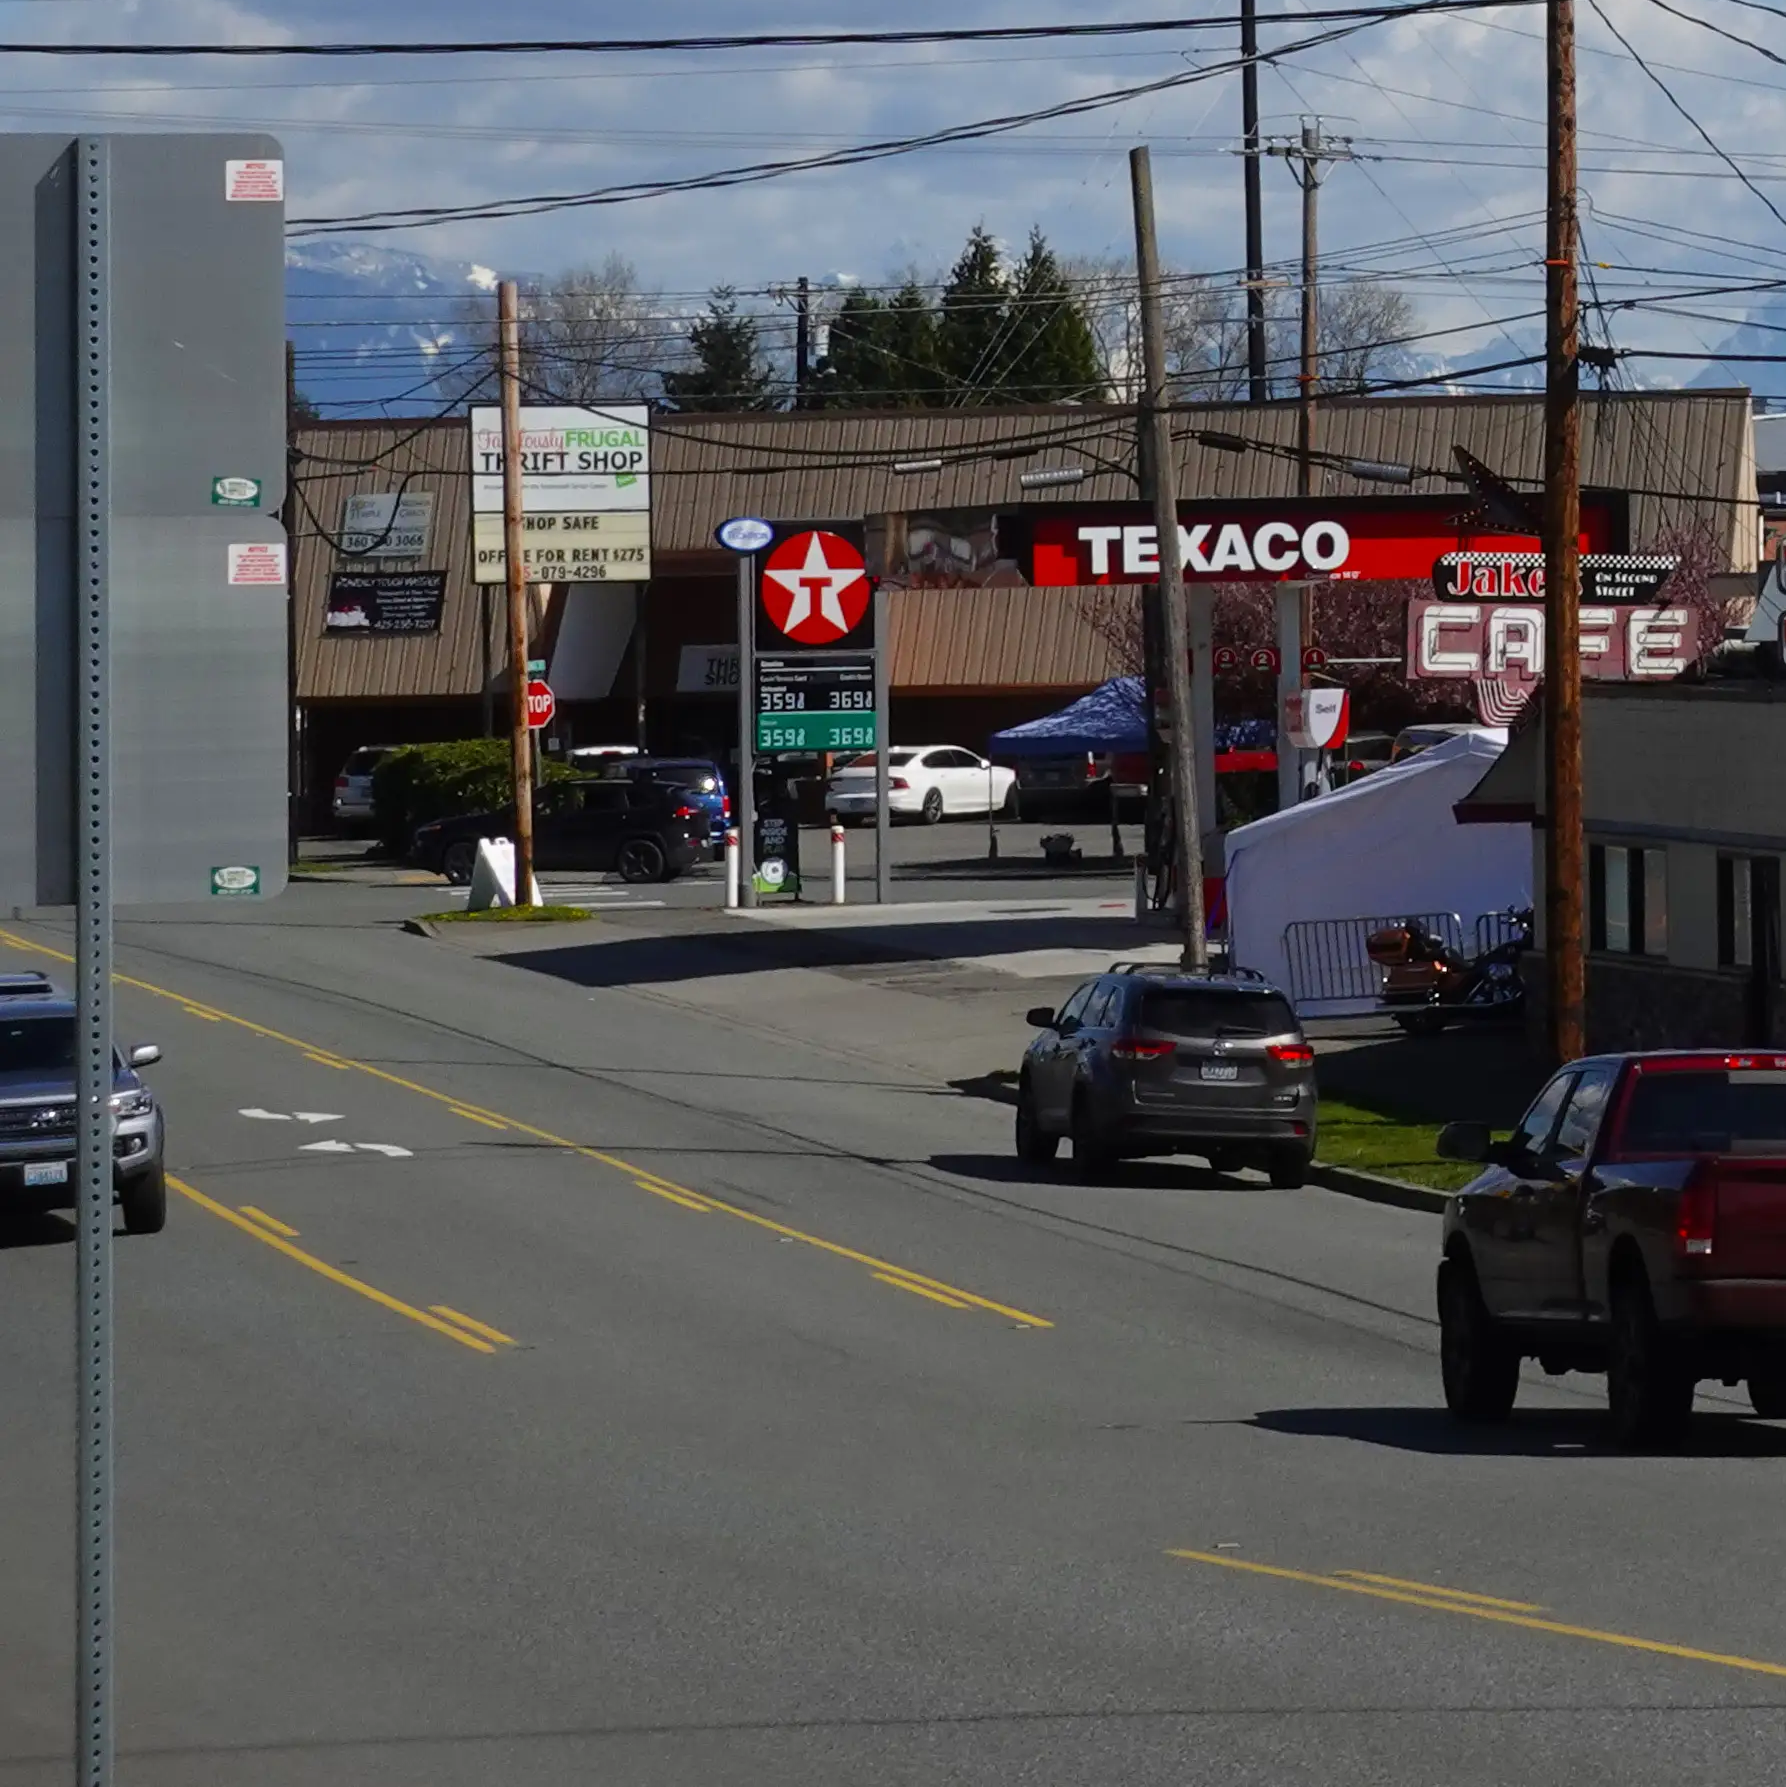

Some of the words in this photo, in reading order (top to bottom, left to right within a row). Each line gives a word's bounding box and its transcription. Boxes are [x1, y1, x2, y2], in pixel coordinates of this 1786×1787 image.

[565, 430, 645, 448] FRUGAL
[578, 451, 643, 470] SHOP
[563, 516, 599, 530] SAFE
[478, 549, 530, 563] OFFE
[536, 549, 567, 563] FOR
[572, 548, 608, 562] RENT
[613, 548, 645, 561] $275
[1078, 521, 1350, 574] TEXACO
[1423, 606, 1688, 674] CAFE
[1222, 653, 1230, 662] 3
[1259, 654, 1267, 663] 2
[528, 694, 551, 713] TOP
[1315, 704, 1336, 714] Self
